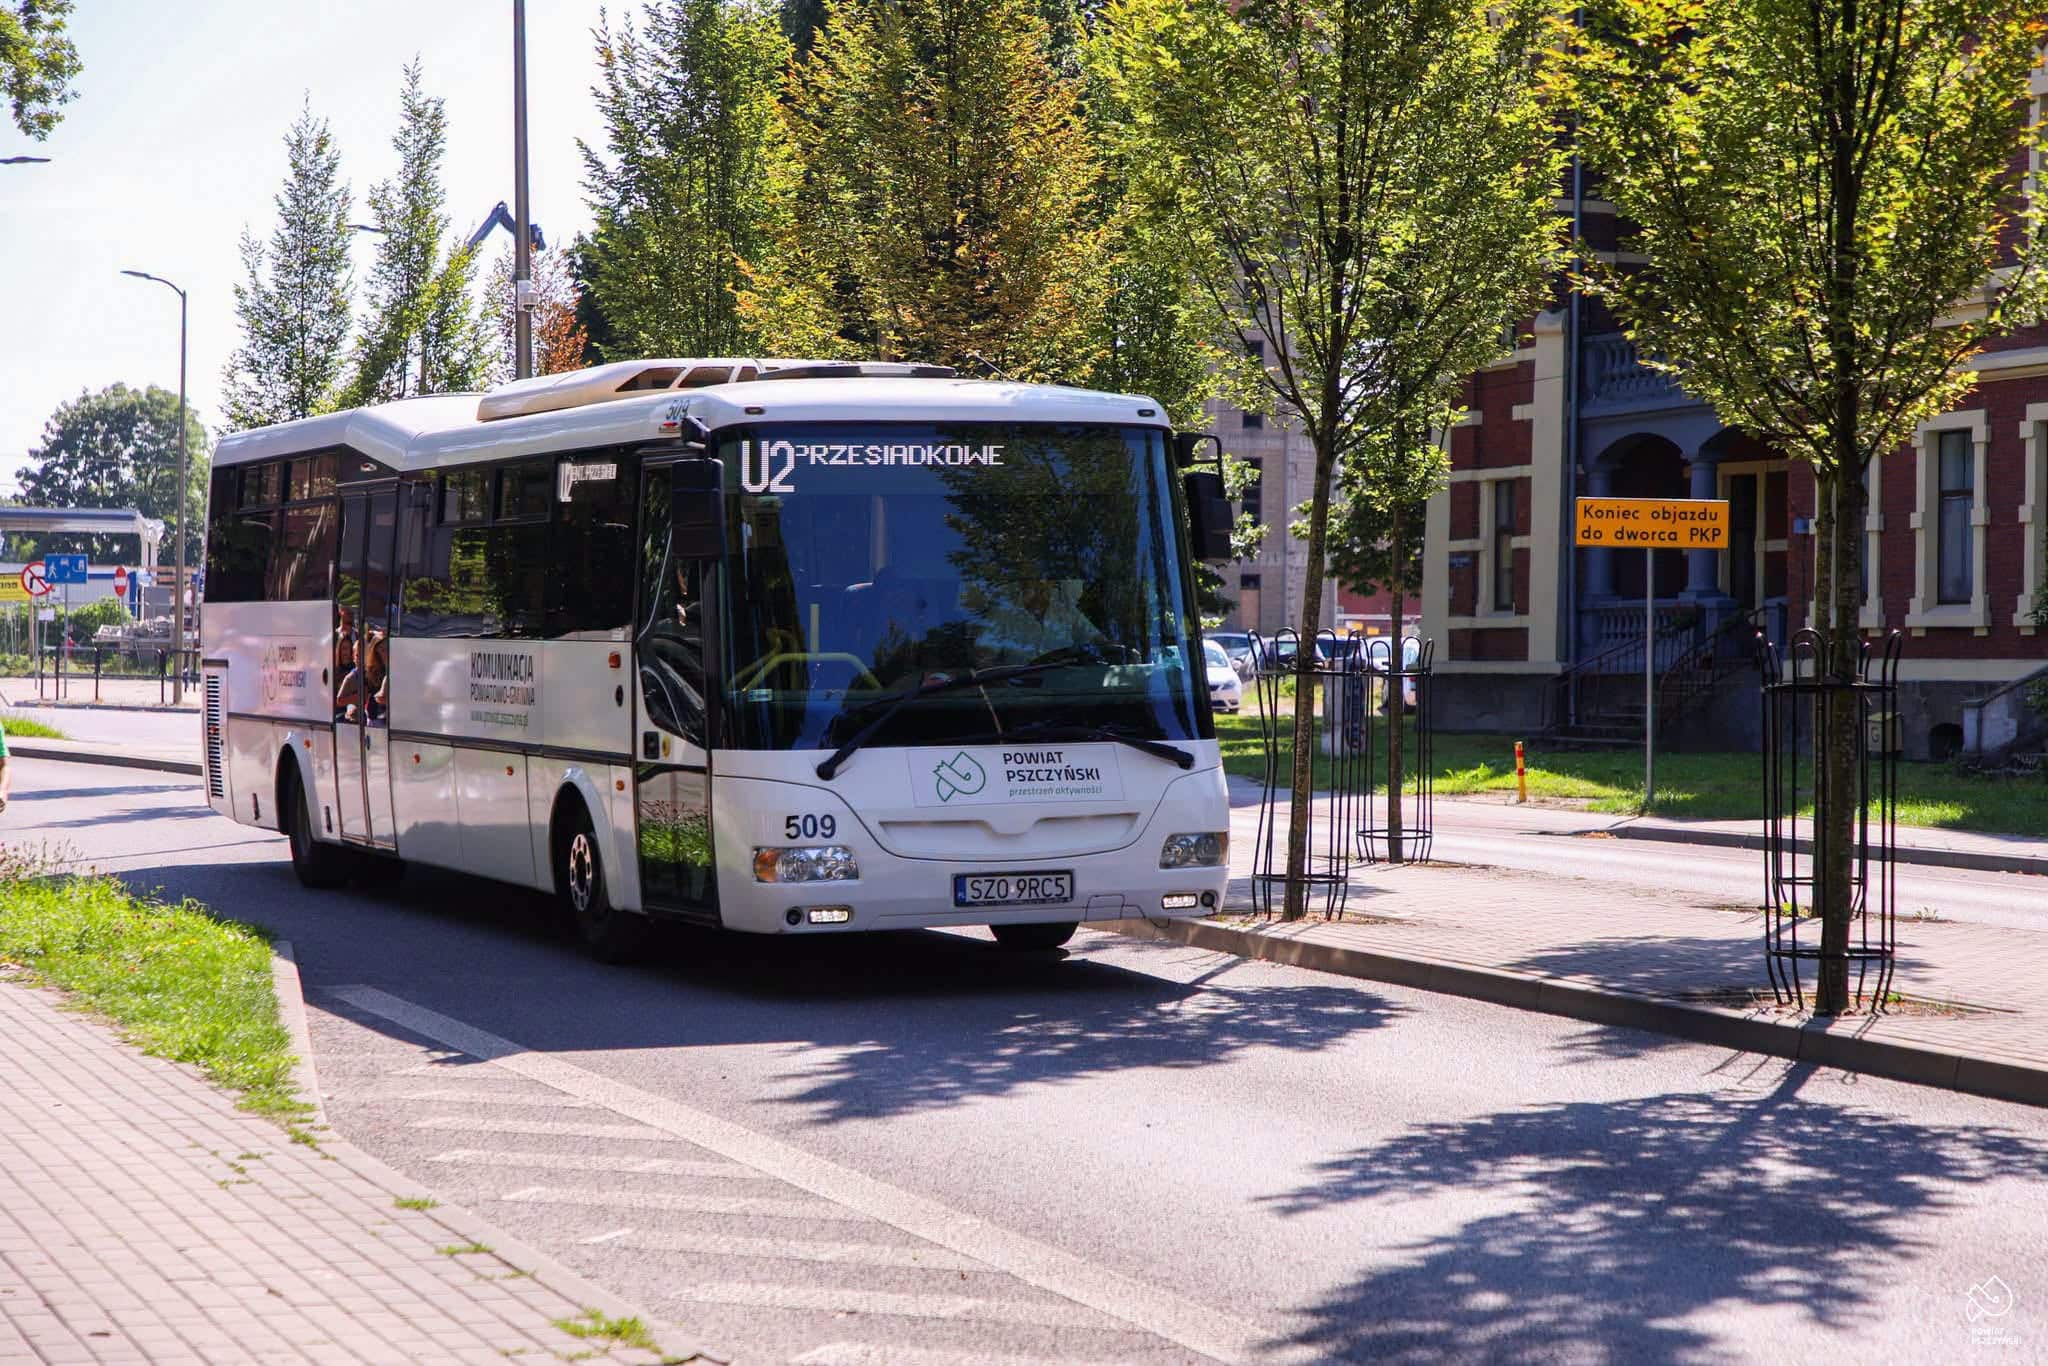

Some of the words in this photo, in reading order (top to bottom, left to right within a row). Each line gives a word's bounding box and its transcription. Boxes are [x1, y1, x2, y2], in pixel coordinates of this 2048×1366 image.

[665, 399, 690, 420] 509
[741, 440, 796, 493] U2
[796, 445, 1004, 465] PRZESIADKOWE
[1584, 505, 1640, 520] Koniec
[1651, 506, 1718, 524] objazdu
[1582, 525, 1603, 540] do
[1615, 526, 1678, 541] dworca
[1690, 528, 1721, 542] PKP
[471, 652, 534, 684] KOMUNIKACJA
[1003, 752, 1063, 765] POWIAT
[1006, 765, 1100, 782] PSZCZYŃSKI
[1009, 785, 1054, 797] przestrzeń
[1055, 784, 1103, 796] aktywności
[785, 814, 836, 840] 509
[1016, 877, 1065, 899] 9RC5
